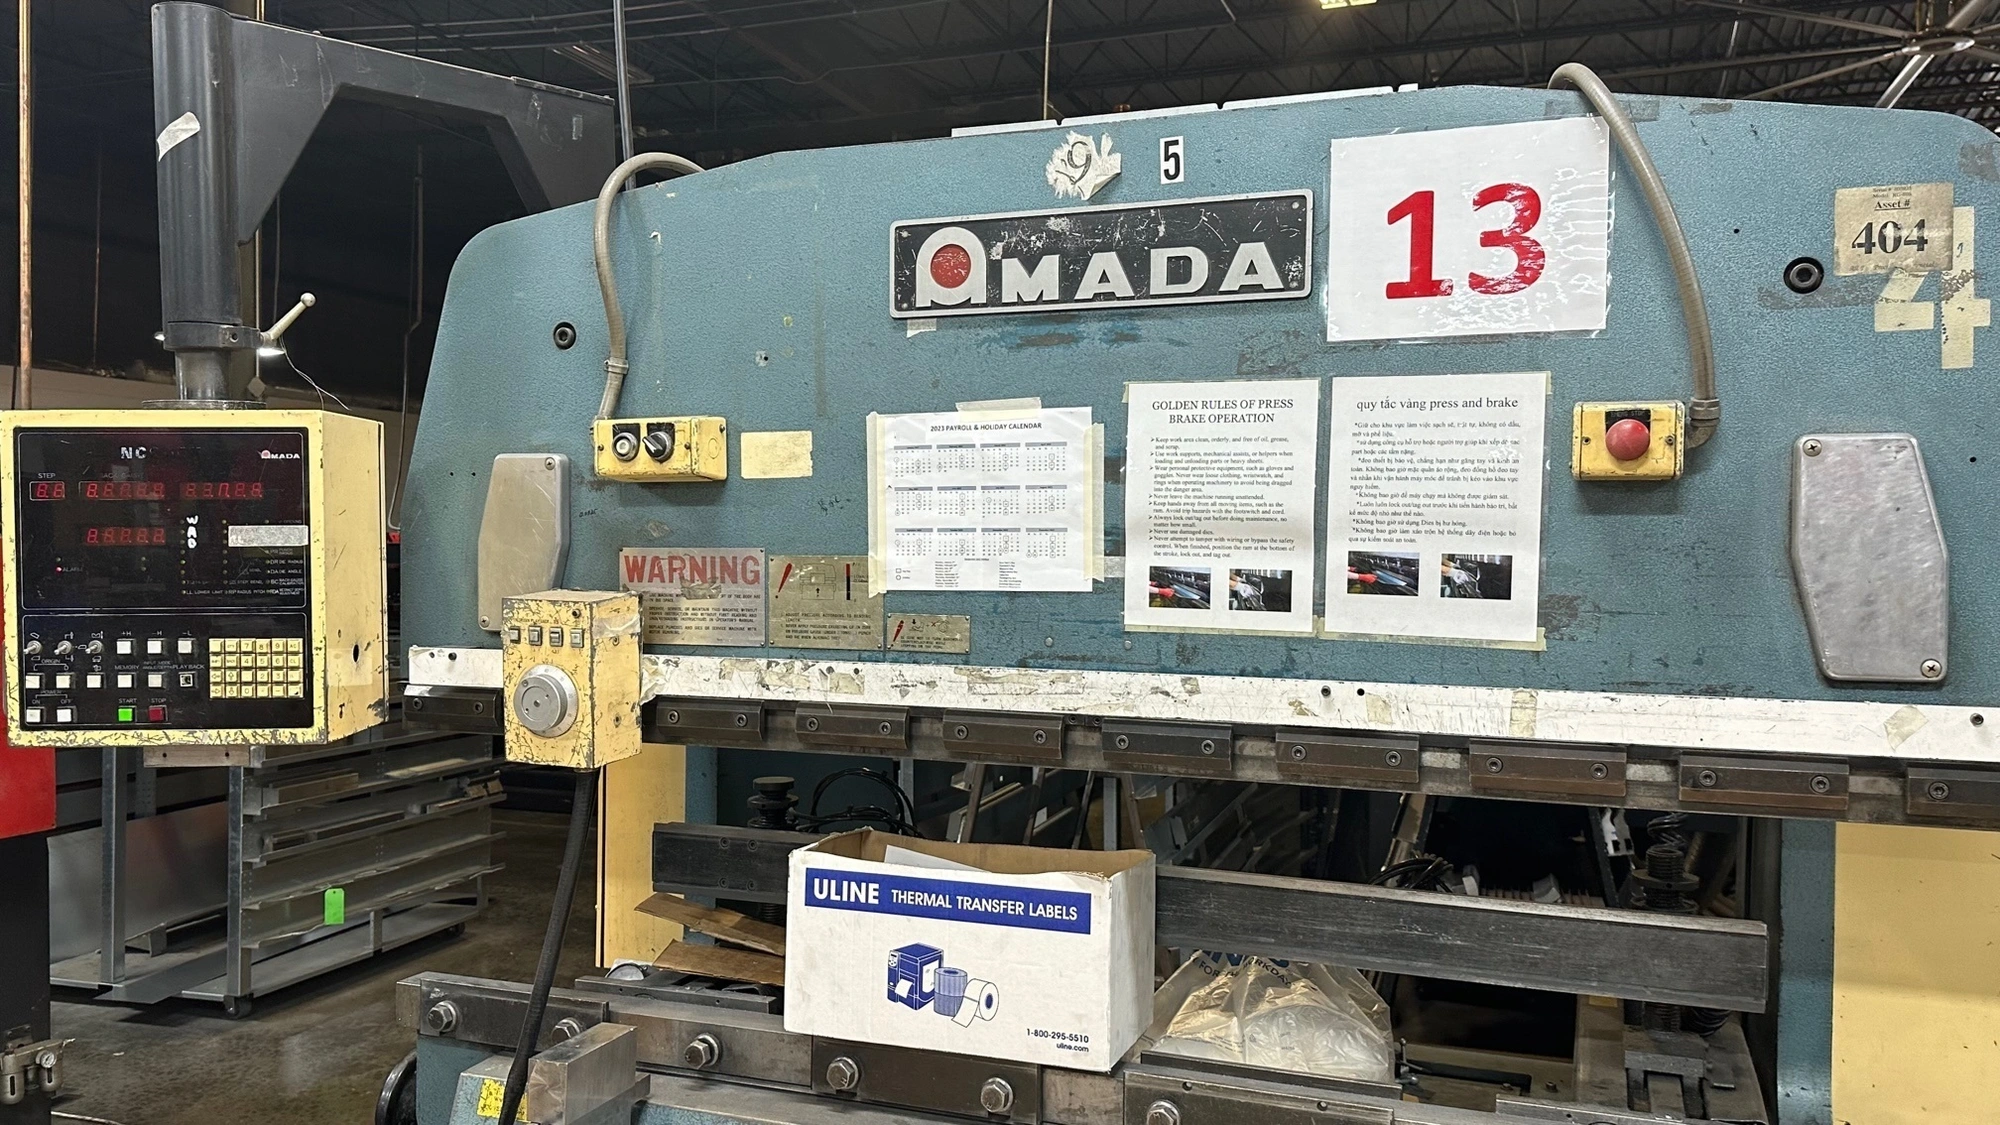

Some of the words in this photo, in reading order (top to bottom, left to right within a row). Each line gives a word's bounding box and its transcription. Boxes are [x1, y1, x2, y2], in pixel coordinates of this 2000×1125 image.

[1163, 139, 1180, 180] 5
[1875, 200, 1901, 208] Asset
[1385, 181, 1547, 300] 13
[1852, 219, 1928, 254] 404
[915, 226, 1284, 308] AMADA
[1152, 400, 1199, 410] GOLDEN
[1201, 400, 1238, 410] RULES
[1240, 400, 1255, 409] OF
[1258, 399, 1294, 409] PRESS
[1356, 401, 1377, 412] quy
[1380, 396, 1396, 409] tắc
[1400, 399, 1426, 411] vàng
[1430, 400, 1458, 411] press
[1461, 397, 1482, 408] and
[1486, 397, 1518, 408] brake
[1169, 414, 1206, 424] BRAKE
[1208, 413, 1275, 423] OPERATION
[624, 555, 760, 585] WARNING
[813, 878, 879, 905] ULINE
[891, 890, 952, 909] THERMAL
[956, 896, 1025, 916] TRANSFER
[1028, 901, 1078, 921] LABELS
[1199, 961, 1220, 977] FOR
[1026, 1028, 1089, 1044] 1-800-295-5510
[1056, 1043, 1089, 1053] uline.com
